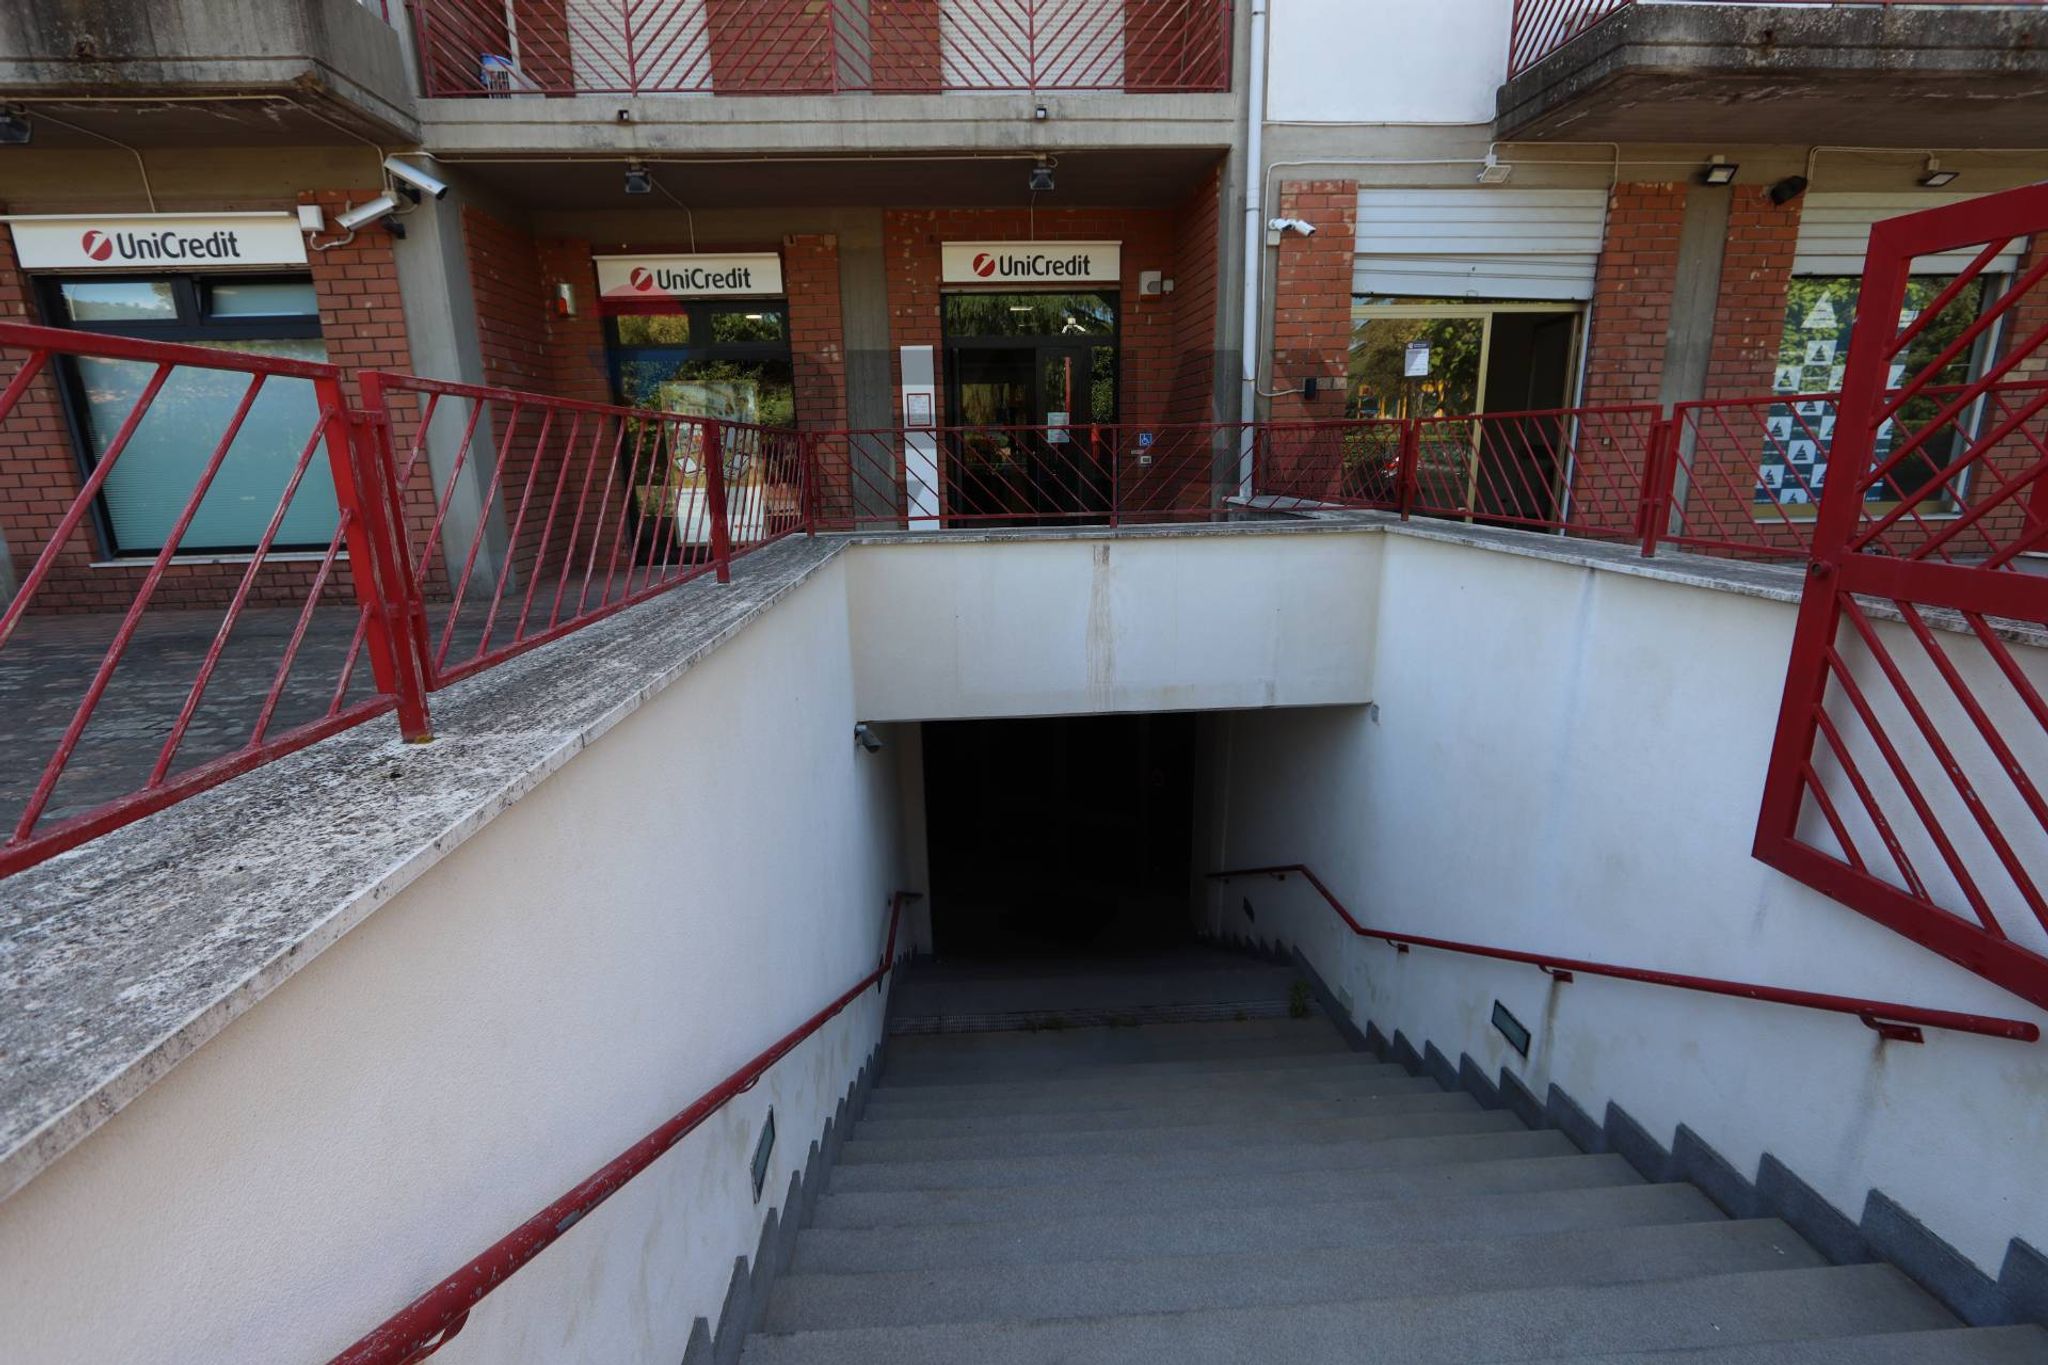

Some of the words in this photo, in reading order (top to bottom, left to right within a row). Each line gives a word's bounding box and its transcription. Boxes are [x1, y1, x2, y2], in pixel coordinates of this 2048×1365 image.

[117, 231, 240, 259] UniCredit
[1000, 254, 1090, 276] UniCredit
[657, 268, 751, 289] UniCredit
